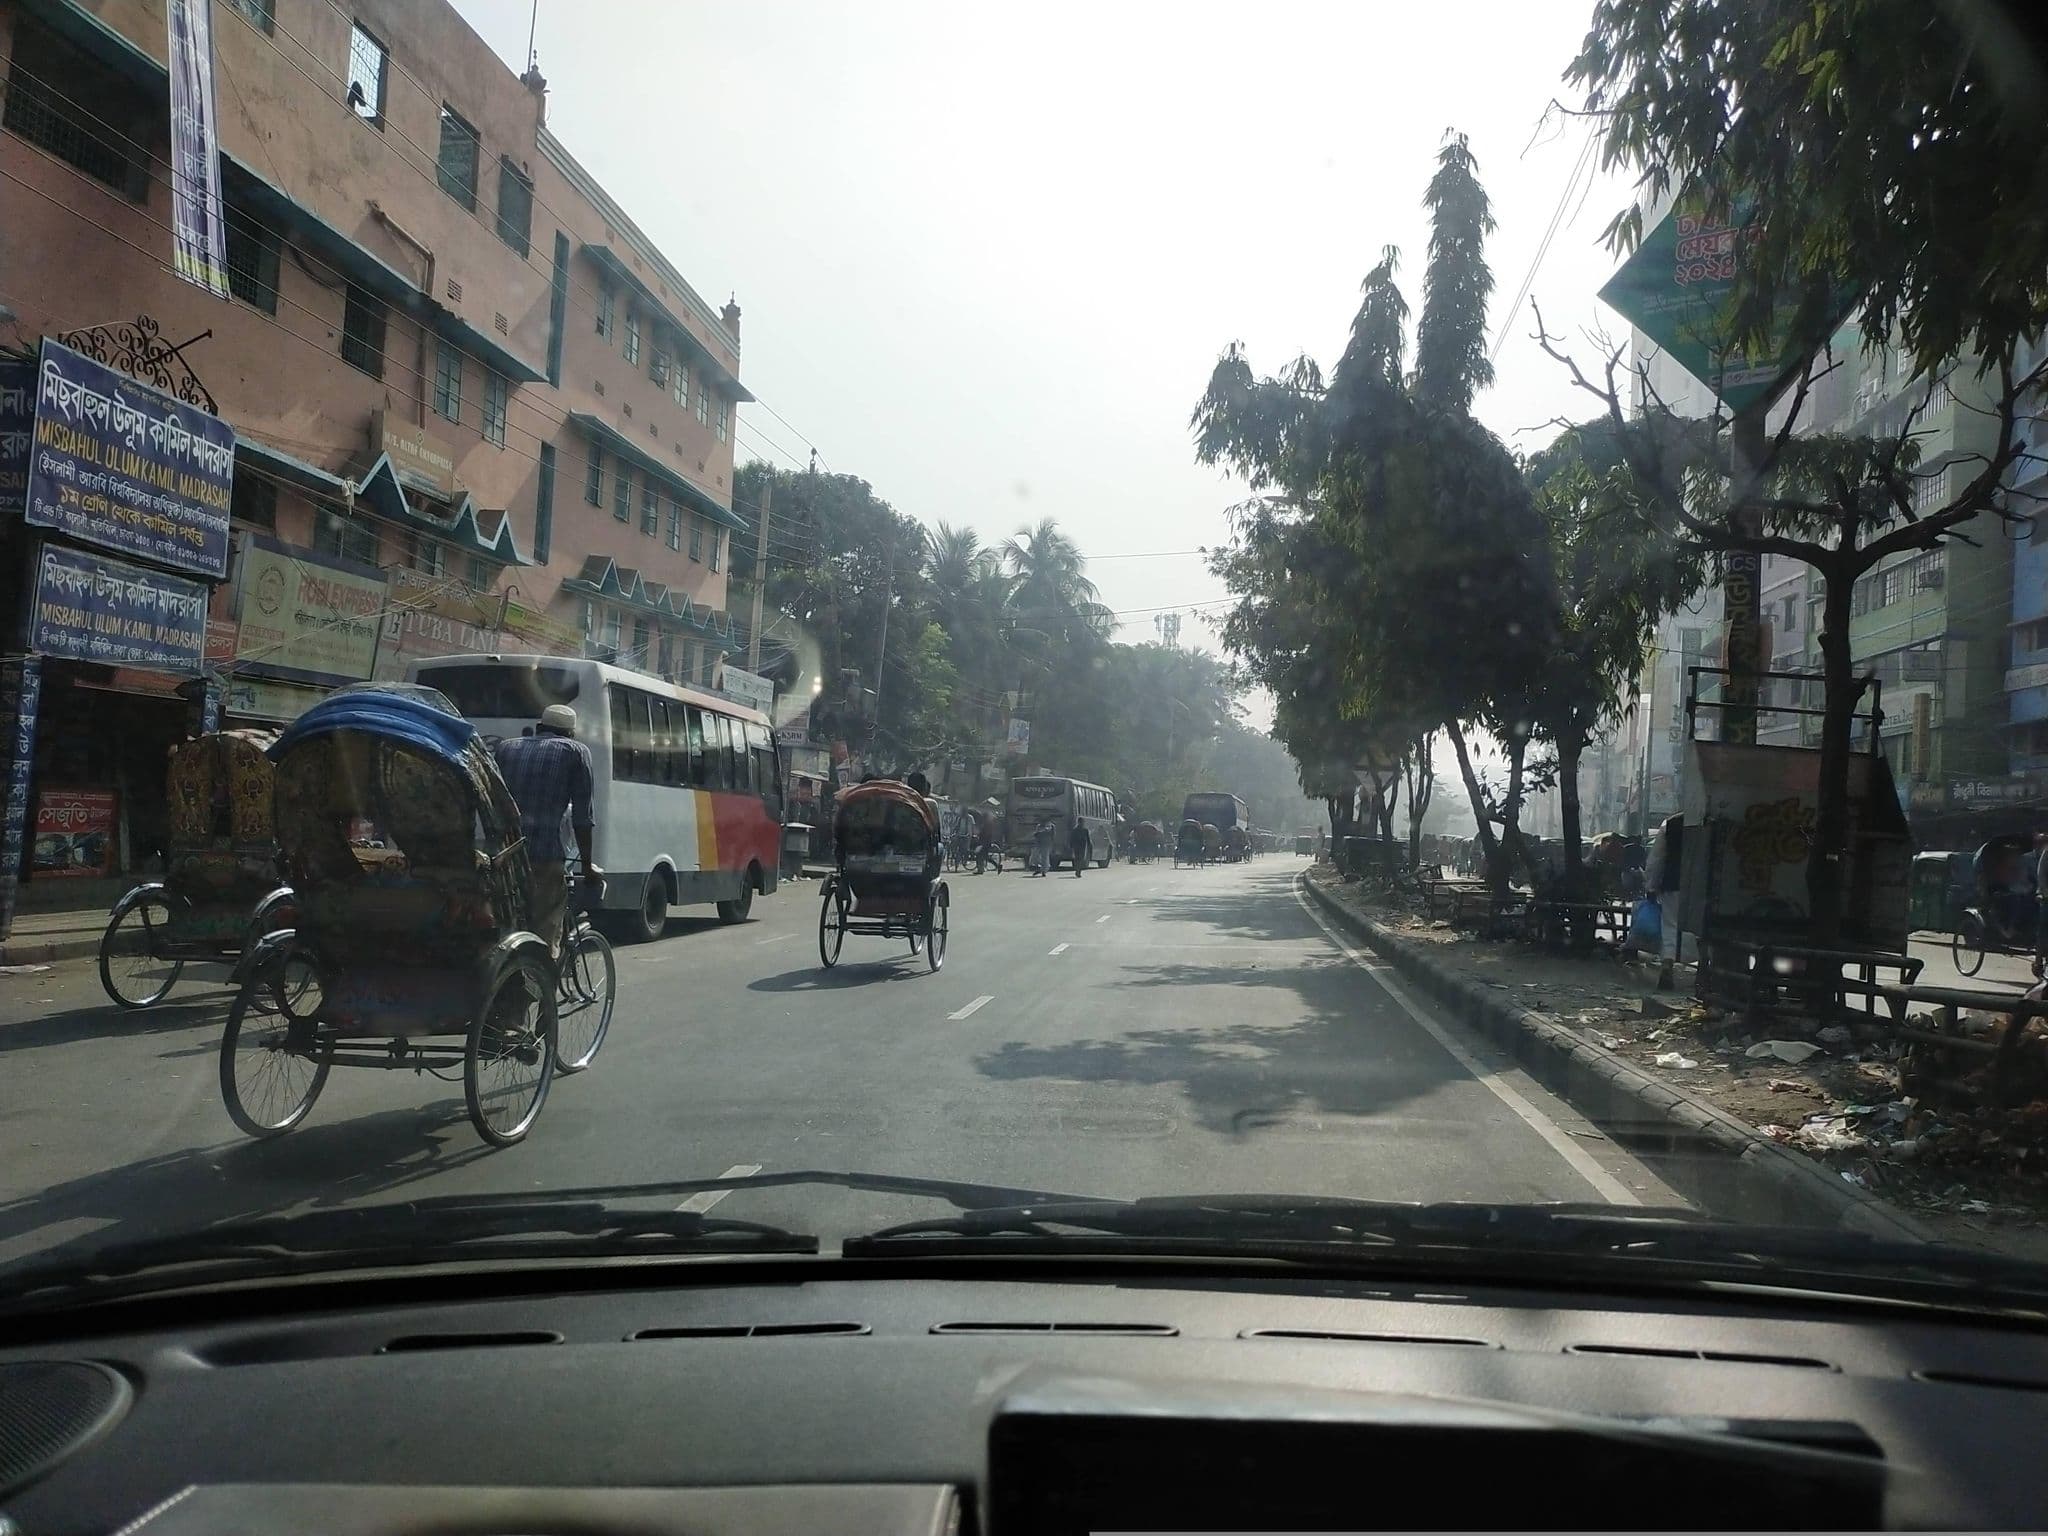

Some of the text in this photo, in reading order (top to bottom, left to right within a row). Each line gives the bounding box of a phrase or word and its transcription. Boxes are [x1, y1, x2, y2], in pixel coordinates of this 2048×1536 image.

[42, 359, 112, 432] মিছবাহুল
[112, 389, 147, 450] উলূম
[150, 414, 190, 463] কামিল
[193, 433, 234, 480] মাদরাসা
[38, 417, 231, 511] MISBAHUL ULUM KAMIL MADRASAH
[38, 451, 76, 483] (ইসলামী
[79, 470, 106, 491] আরবি
[60, 485, 80, 509] ১ম
[112, 503, 141, 526] থেকে
[142, 514, 177, 540] কামিল
[126, 578, 158, 611] কামিল
[158, 588, 202, 620] মাদরাসা
[41, 603, 92, 630] MISBAHUL
[95, 614, 121, 636] ULUM
[123, 619, 153, 642] KAMIL
[155, 625, 201, 650] MADRASAH
[405, 610, 452, 643] TUBA
